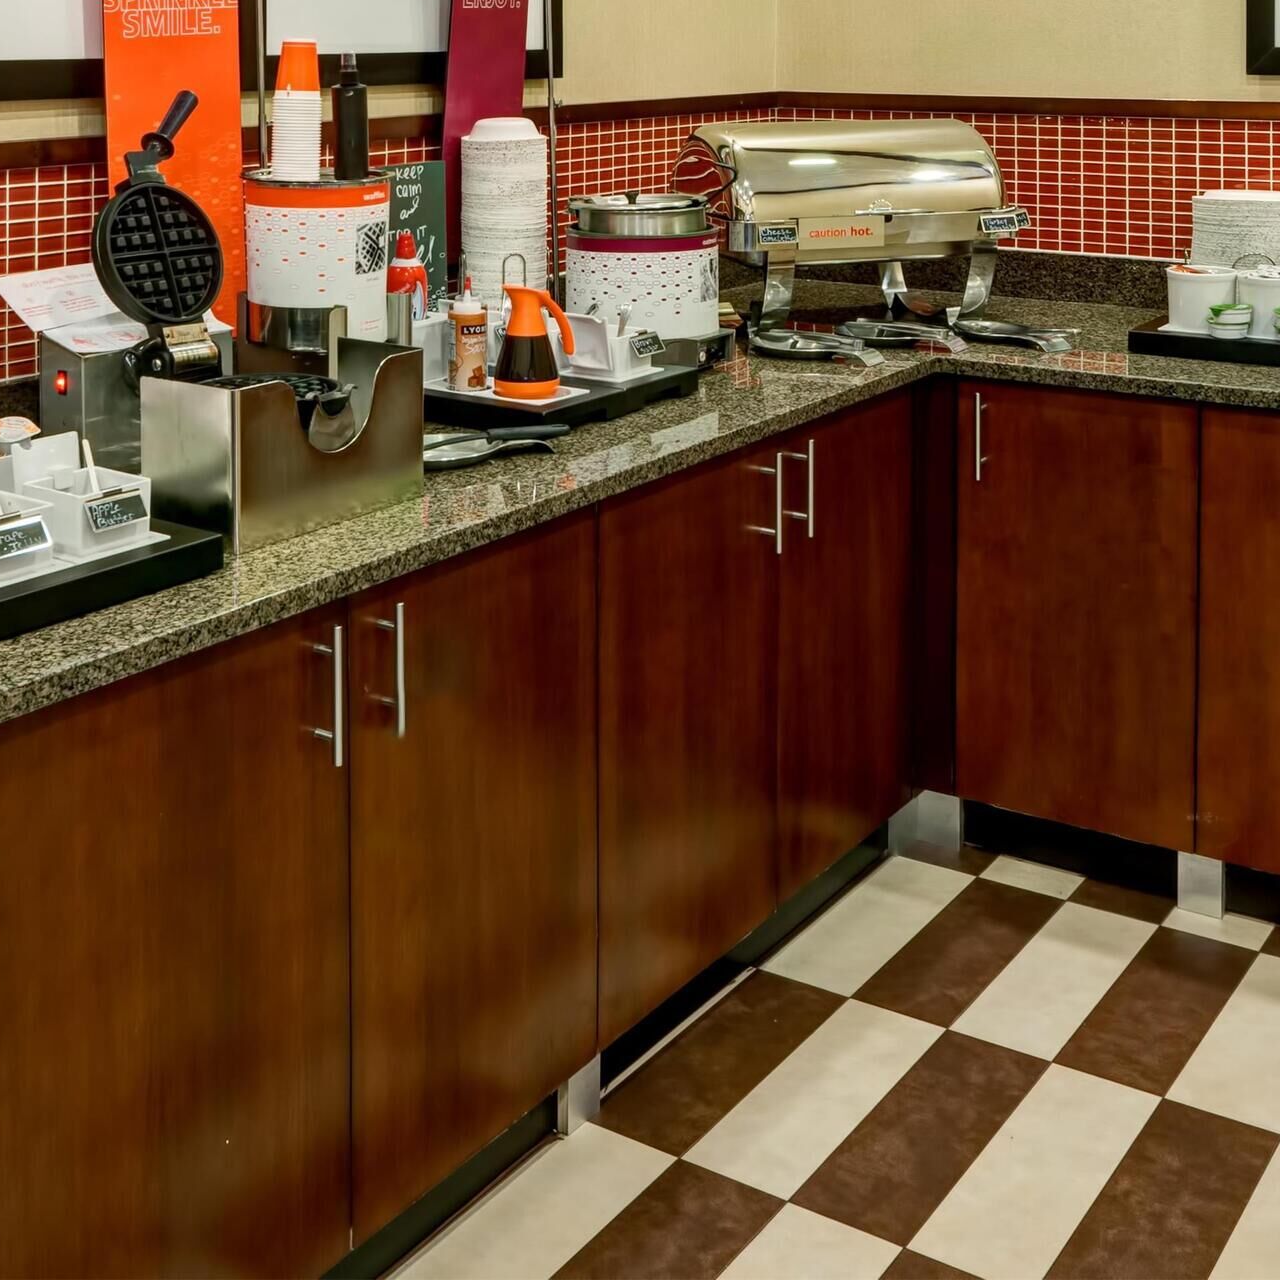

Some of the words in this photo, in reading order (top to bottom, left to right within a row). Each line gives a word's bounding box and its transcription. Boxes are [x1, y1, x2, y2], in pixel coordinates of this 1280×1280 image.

[121, 7, 222, 39] SMILE.
[809, 228, 847, 238] caution
[850, 226, 874, 237] hot.
